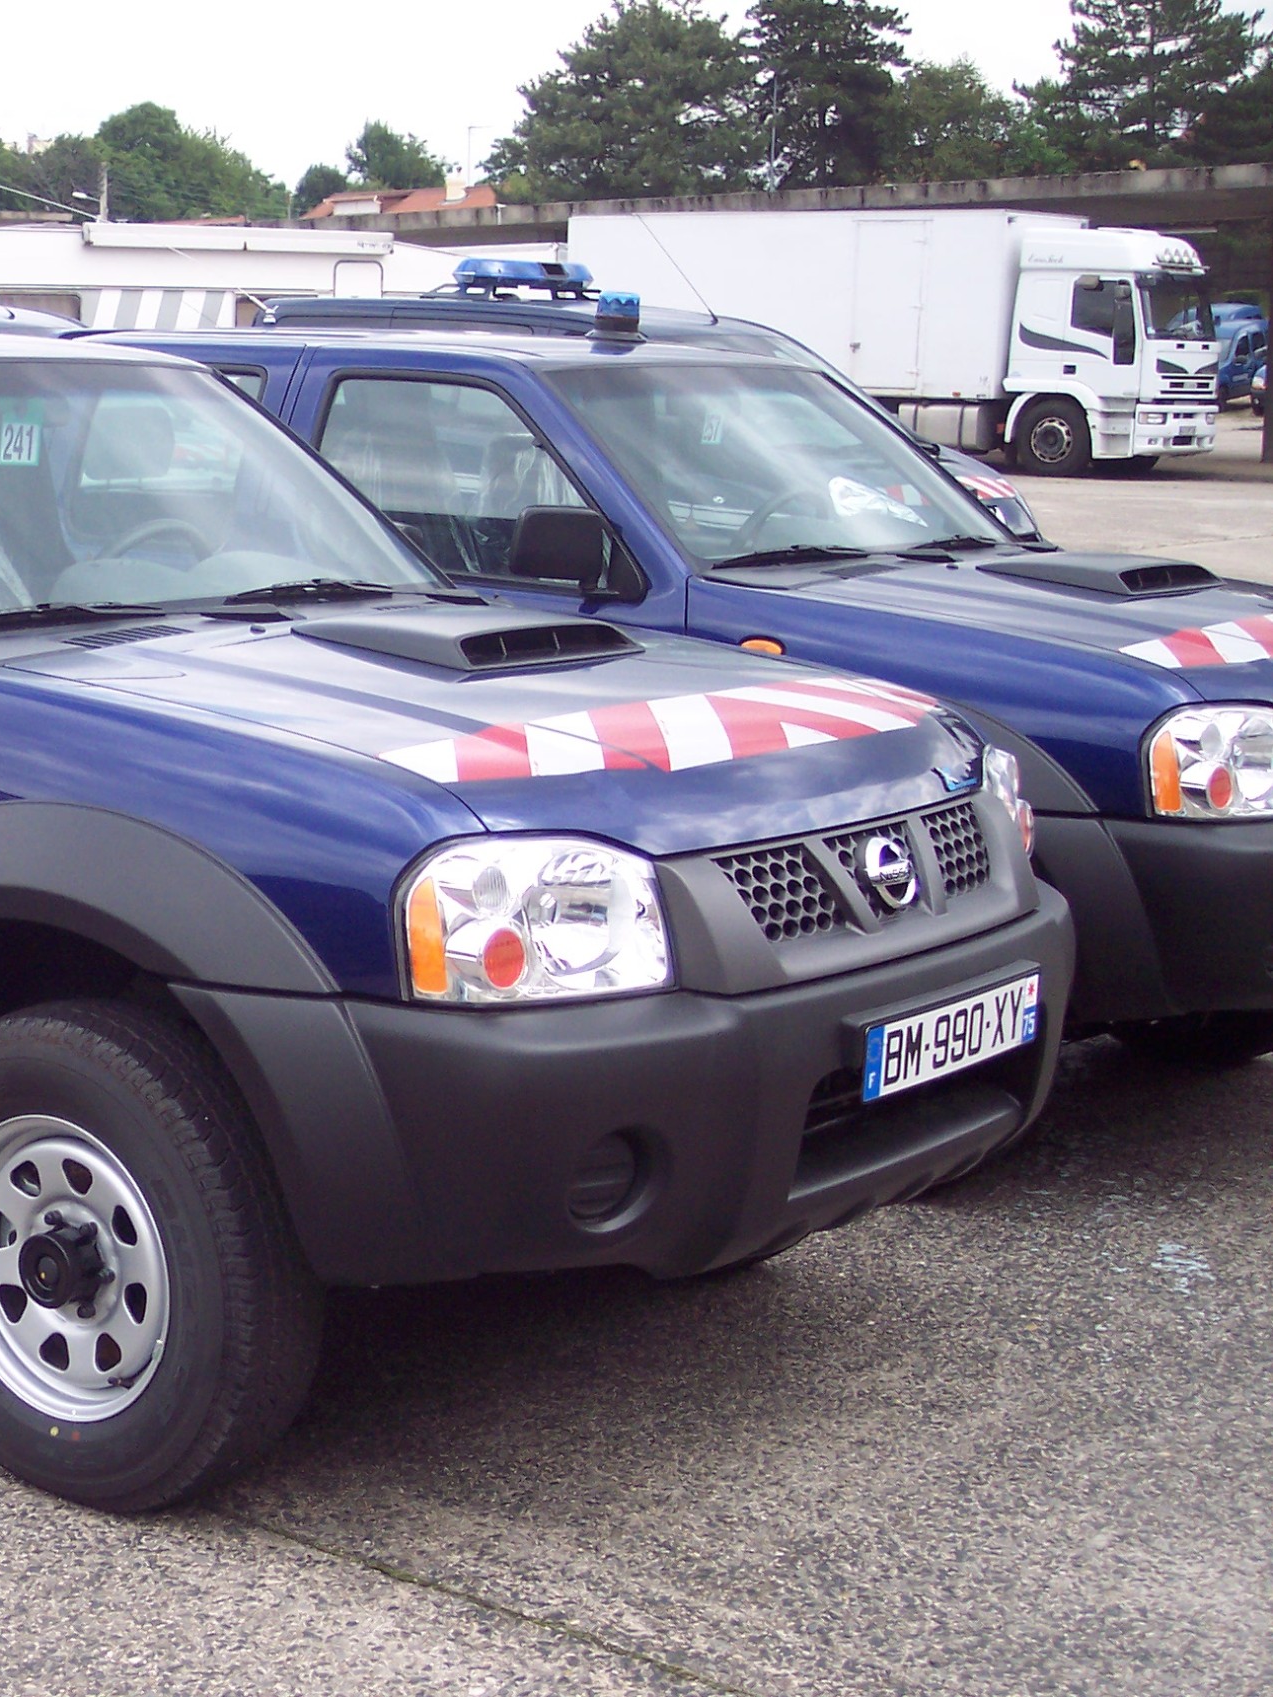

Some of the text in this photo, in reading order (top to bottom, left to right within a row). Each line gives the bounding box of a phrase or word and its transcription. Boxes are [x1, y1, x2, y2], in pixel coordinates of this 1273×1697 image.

[2, 424, 34, 461] 241
[1022, 1011, 1036, 1038] 75
[868, 1071, 876, 1090] F
